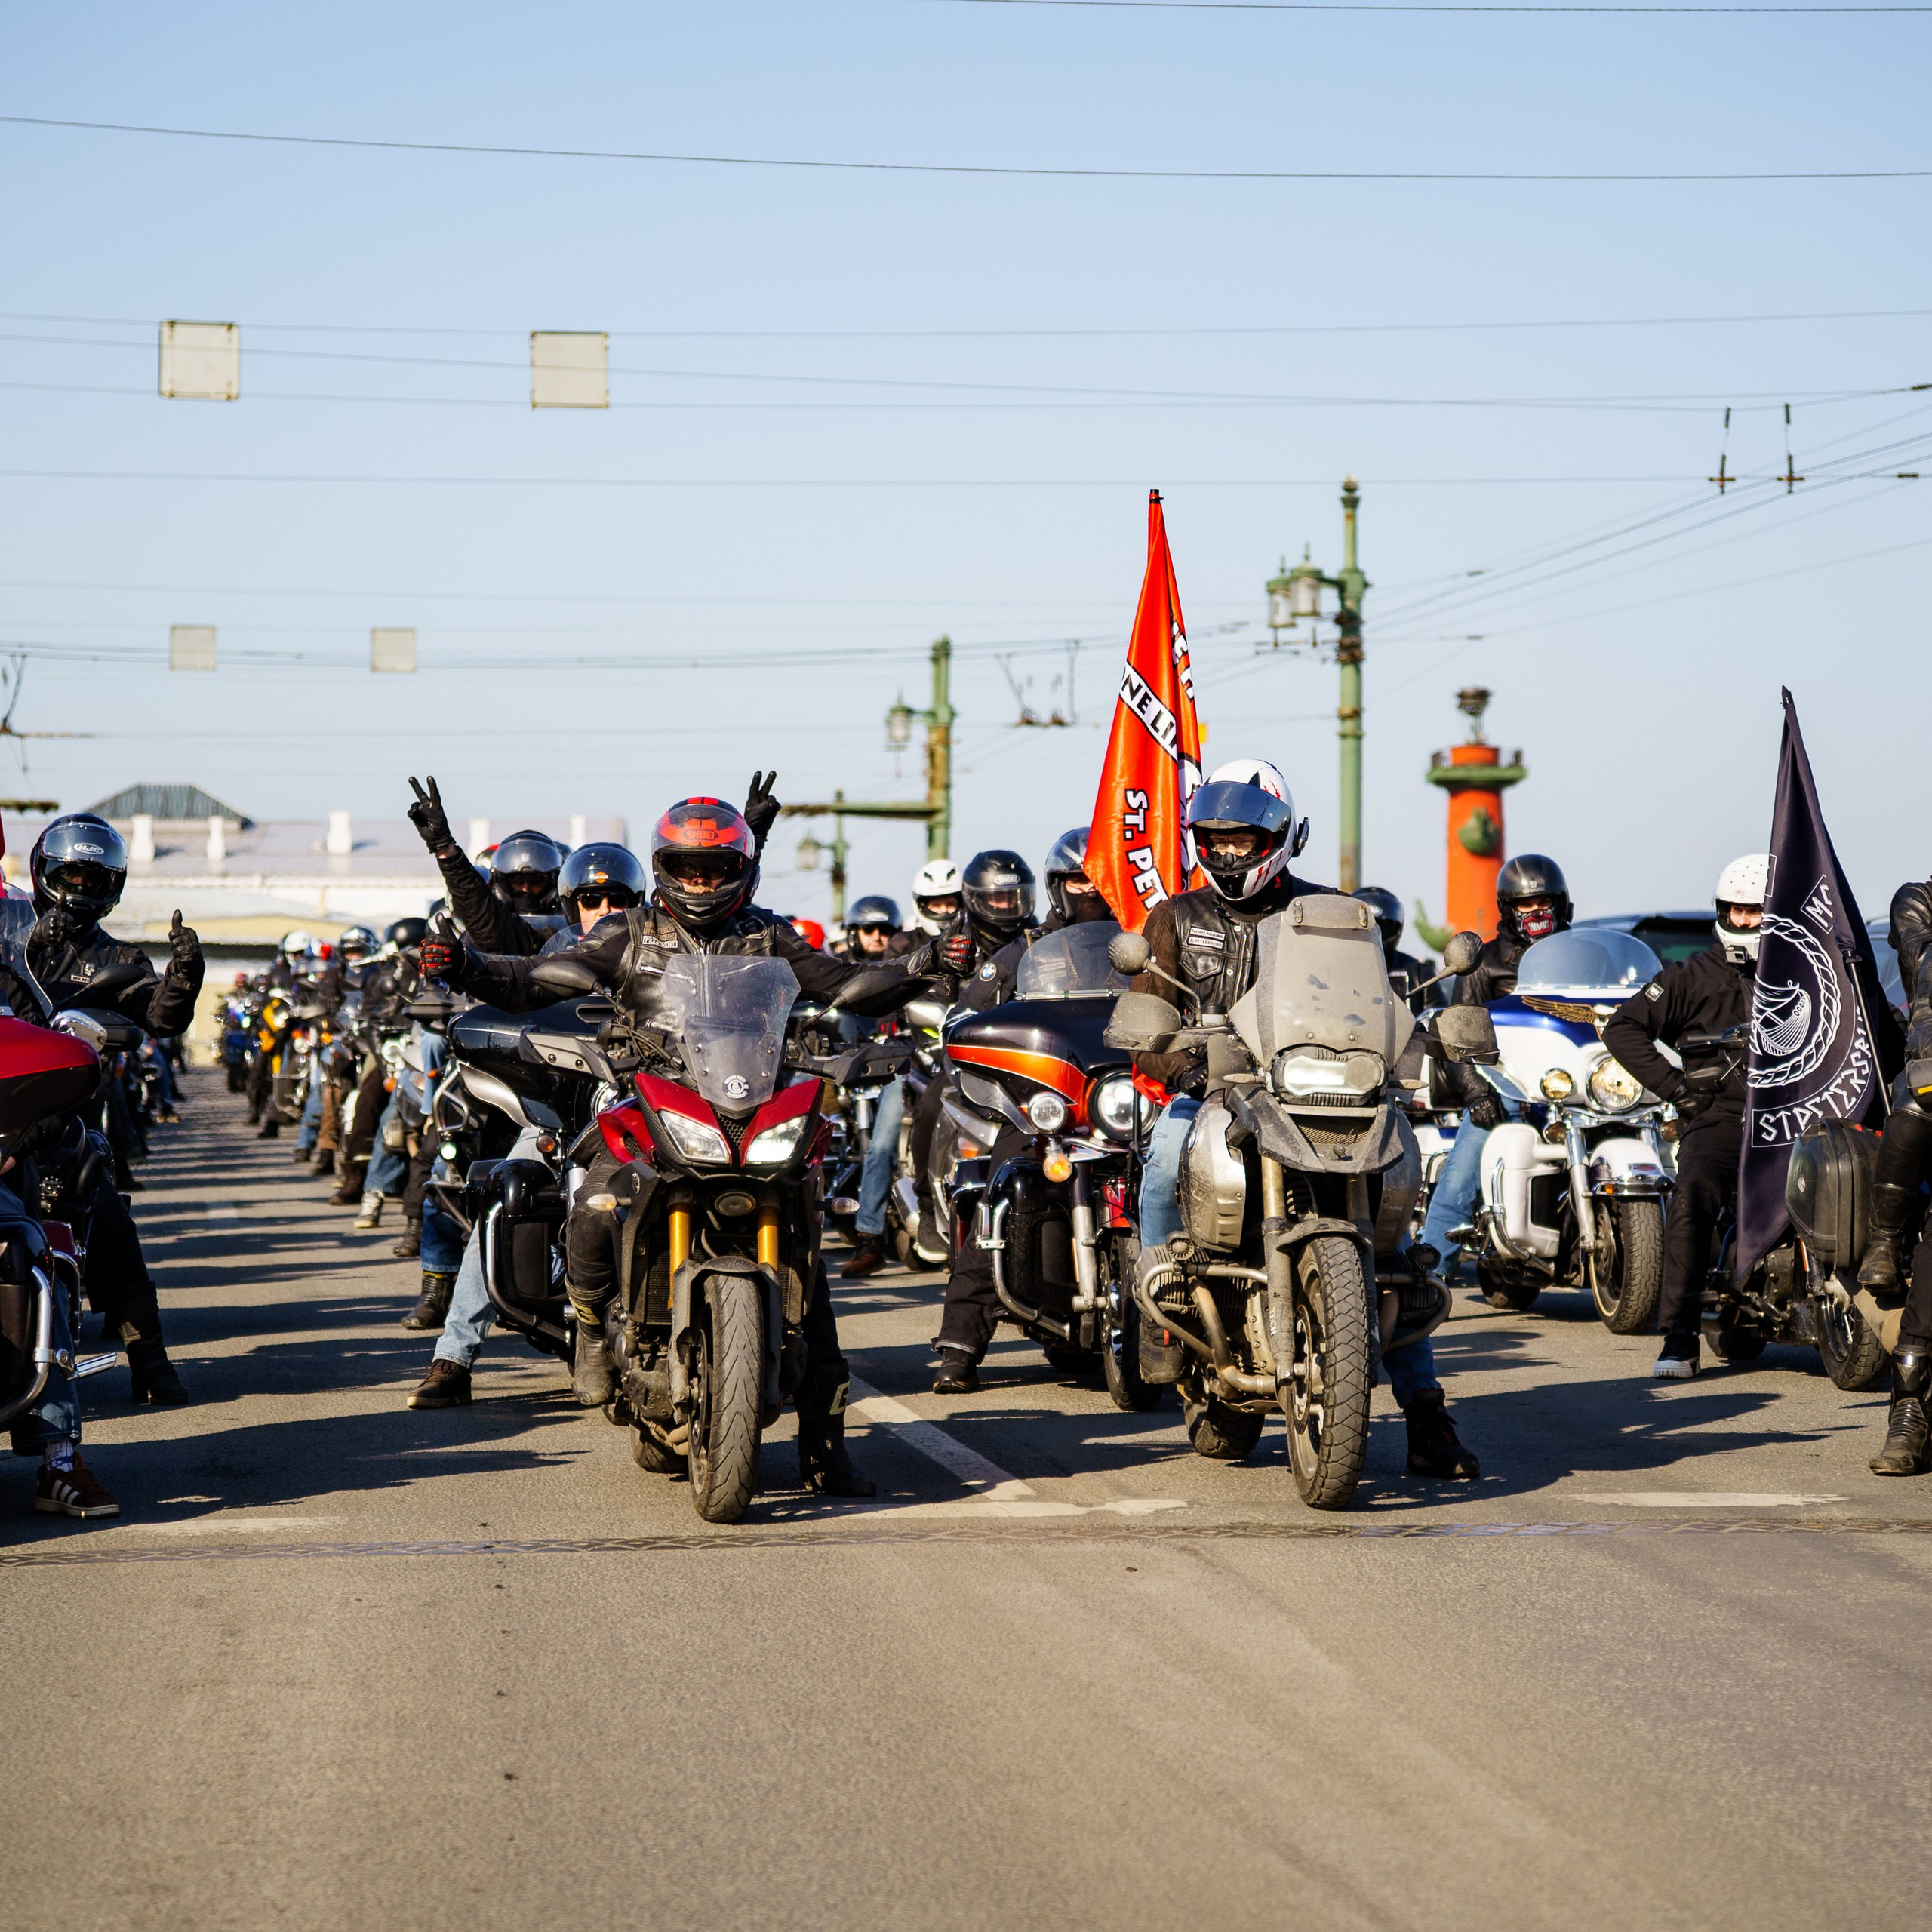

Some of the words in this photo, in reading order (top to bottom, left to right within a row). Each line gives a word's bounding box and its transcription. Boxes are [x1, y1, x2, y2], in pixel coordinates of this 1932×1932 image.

[1121, 667, 1152, 715] NE
[1124, 788, 1149, 841] ST.
[686, 830, 715, 840] SHOEI
[76, 844, 101, 854] HJC
[1191, 928, 1223, 939] HOOLIGANS
